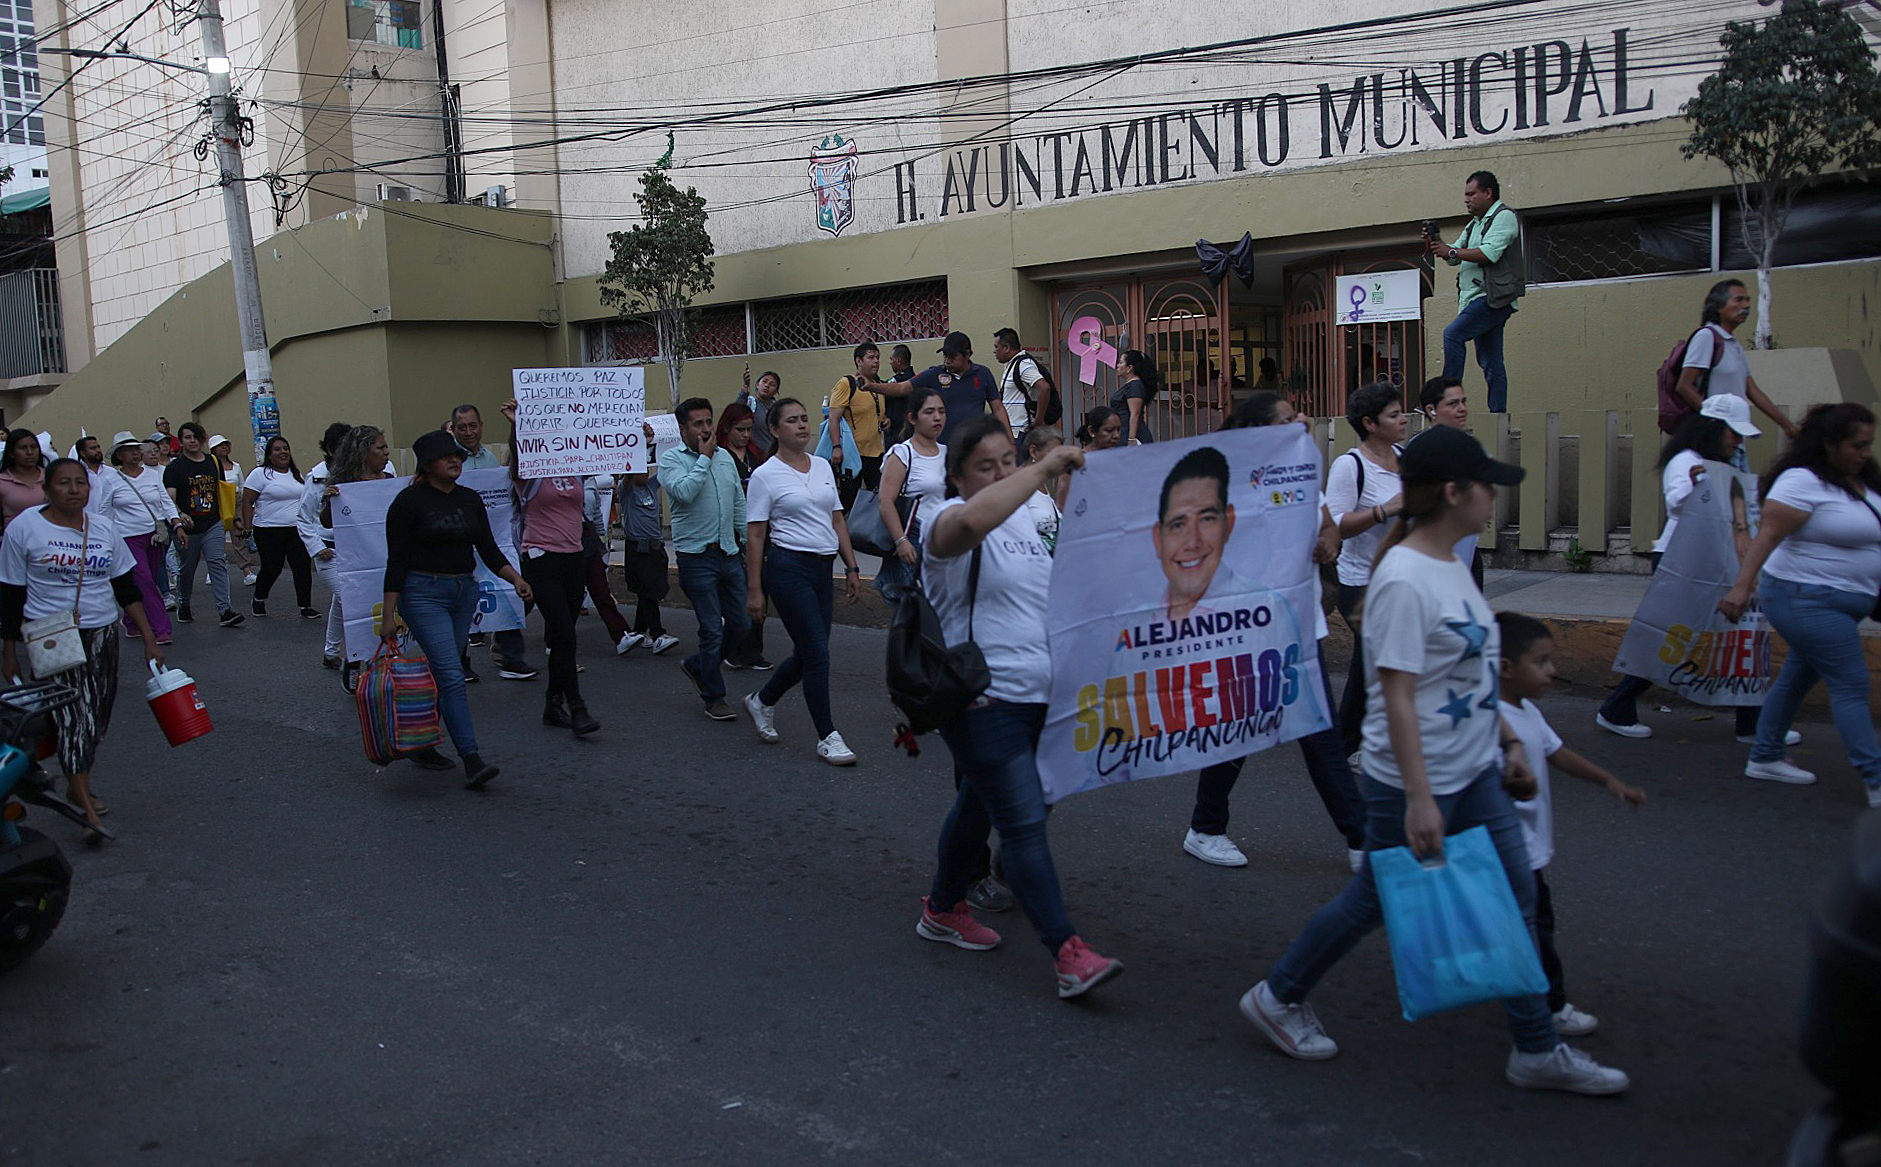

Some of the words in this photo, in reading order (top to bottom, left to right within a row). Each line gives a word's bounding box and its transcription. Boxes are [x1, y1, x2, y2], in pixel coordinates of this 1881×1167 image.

[896, 162, 926, 224] H.
[939, 92, 1290, 217] AYUNTAMIENTO
[1316, 28, 1655, 159] MUNICIPAL
[519, 370, 584, 384] QUEREMOS
[593, 370, 616, 383] PAZ
[623, 372, 633, 385] Y
[579, 387, 602, 398] POR
[607, 387, 645, 401] TODOS
[518, 404, 541, 416] LOS
[543, 403, 567, 415] QUE
[567, 403, 586, 413] NO
[587, 402, 645, 415] MERECIAN
[573, 416, 644, 429] QUEREMOS
[517, 438, 549, 454] VIVIR
[552, 436, 580, 451] SIN
[584, 433, 639, 450] MIEDO
[1115, 605, 1272, 652] ALEJANDRO
[1142, 635, 1245, 660] PRESIDENTE
[1074, 643, 1300, 752] SALVEMOS
